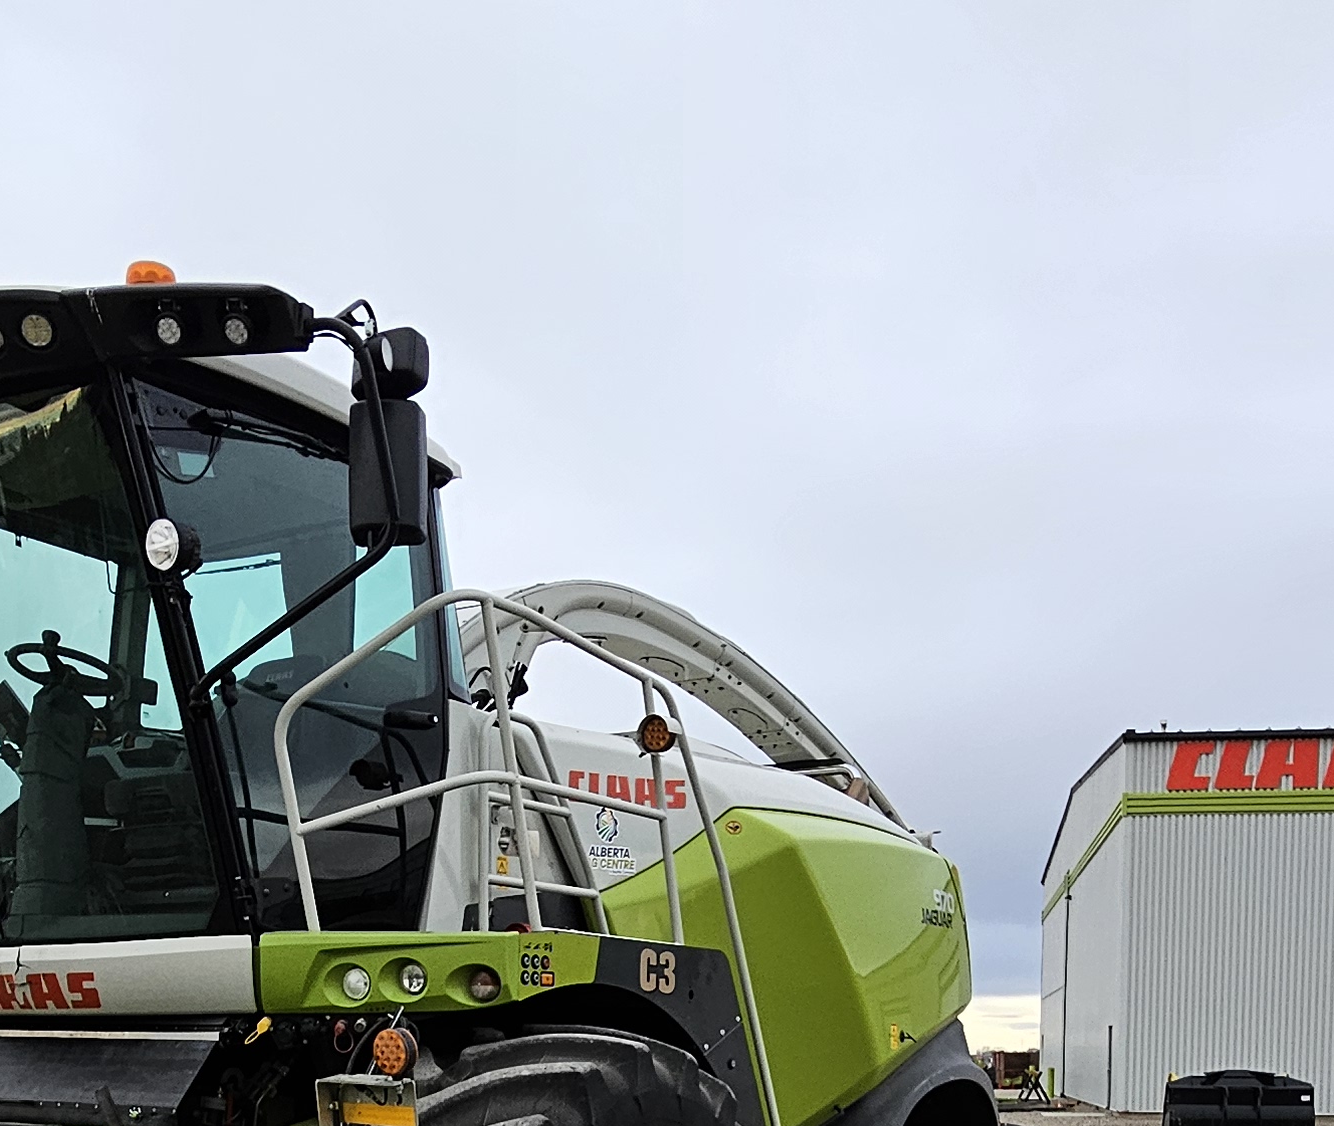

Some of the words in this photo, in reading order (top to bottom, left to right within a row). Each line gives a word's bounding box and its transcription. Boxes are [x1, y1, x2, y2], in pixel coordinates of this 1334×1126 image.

[568, 769, 687, 810] CLAAS
[588, 846, 631, 859] ALBERTA
[600, 858, 636, 870] CENTRE
[932, 888, 955, 914] 970
[920, 907, 953, 929] JAGUAR
[639, 947, 676, 995] C3
